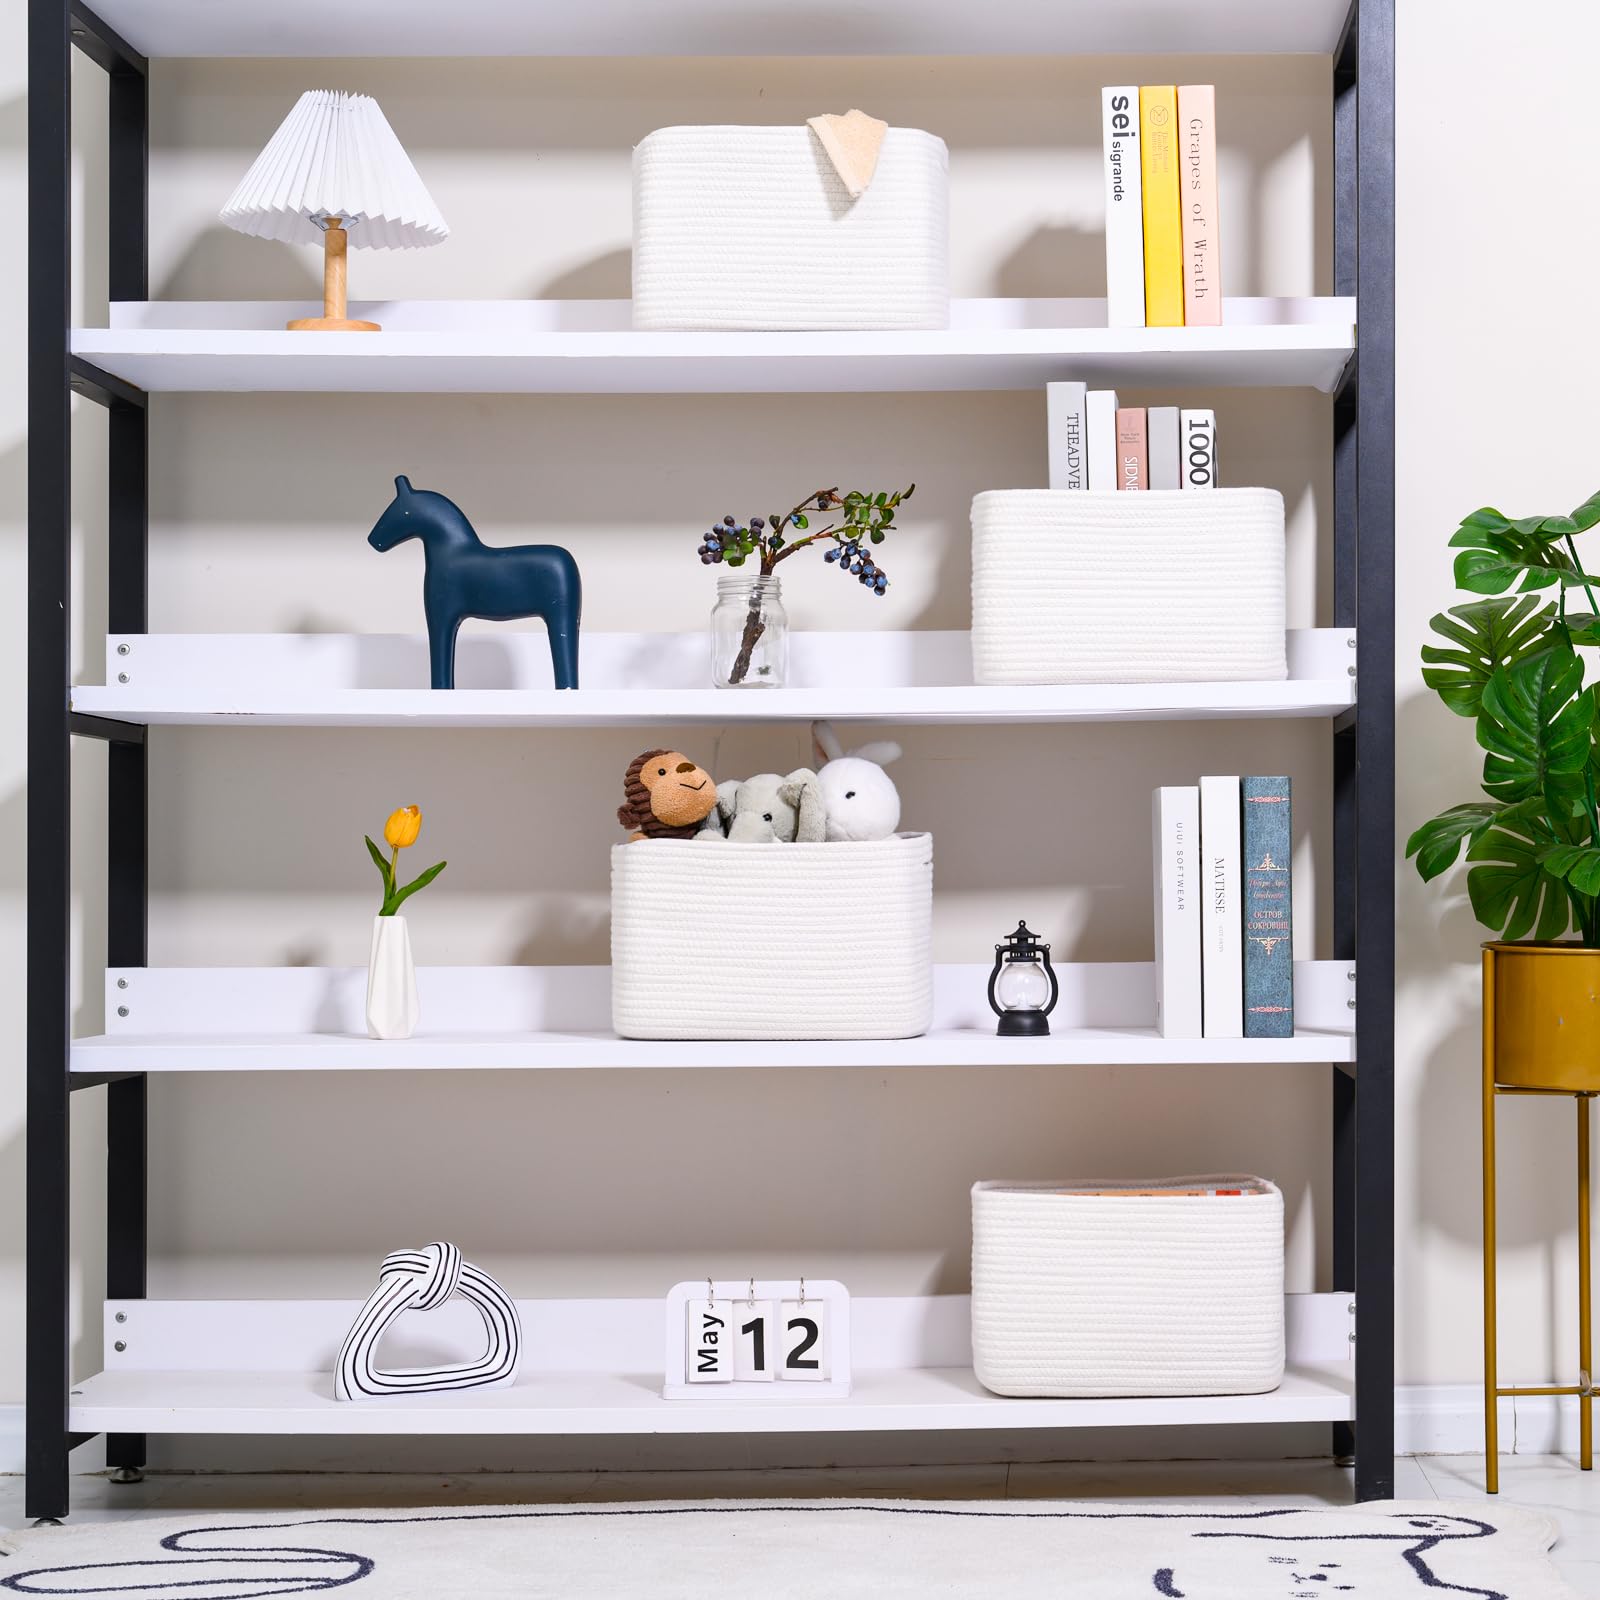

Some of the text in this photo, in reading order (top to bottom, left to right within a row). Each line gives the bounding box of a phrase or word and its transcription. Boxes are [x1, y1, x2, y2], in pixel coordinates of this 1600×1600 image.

[1111, 96, 1136, 138] sei
[1110, 141, 1125, 202] sigrande
[1188, 118, 1209, 299] Grapes of Wrath
[1188, 419, 1211, 485] 1000
[1176, 850, 1185, 911] SOFTWEAR
[1214, 858, 1226, 914] MATISSE
[697, 1313, 725, 1373] May
